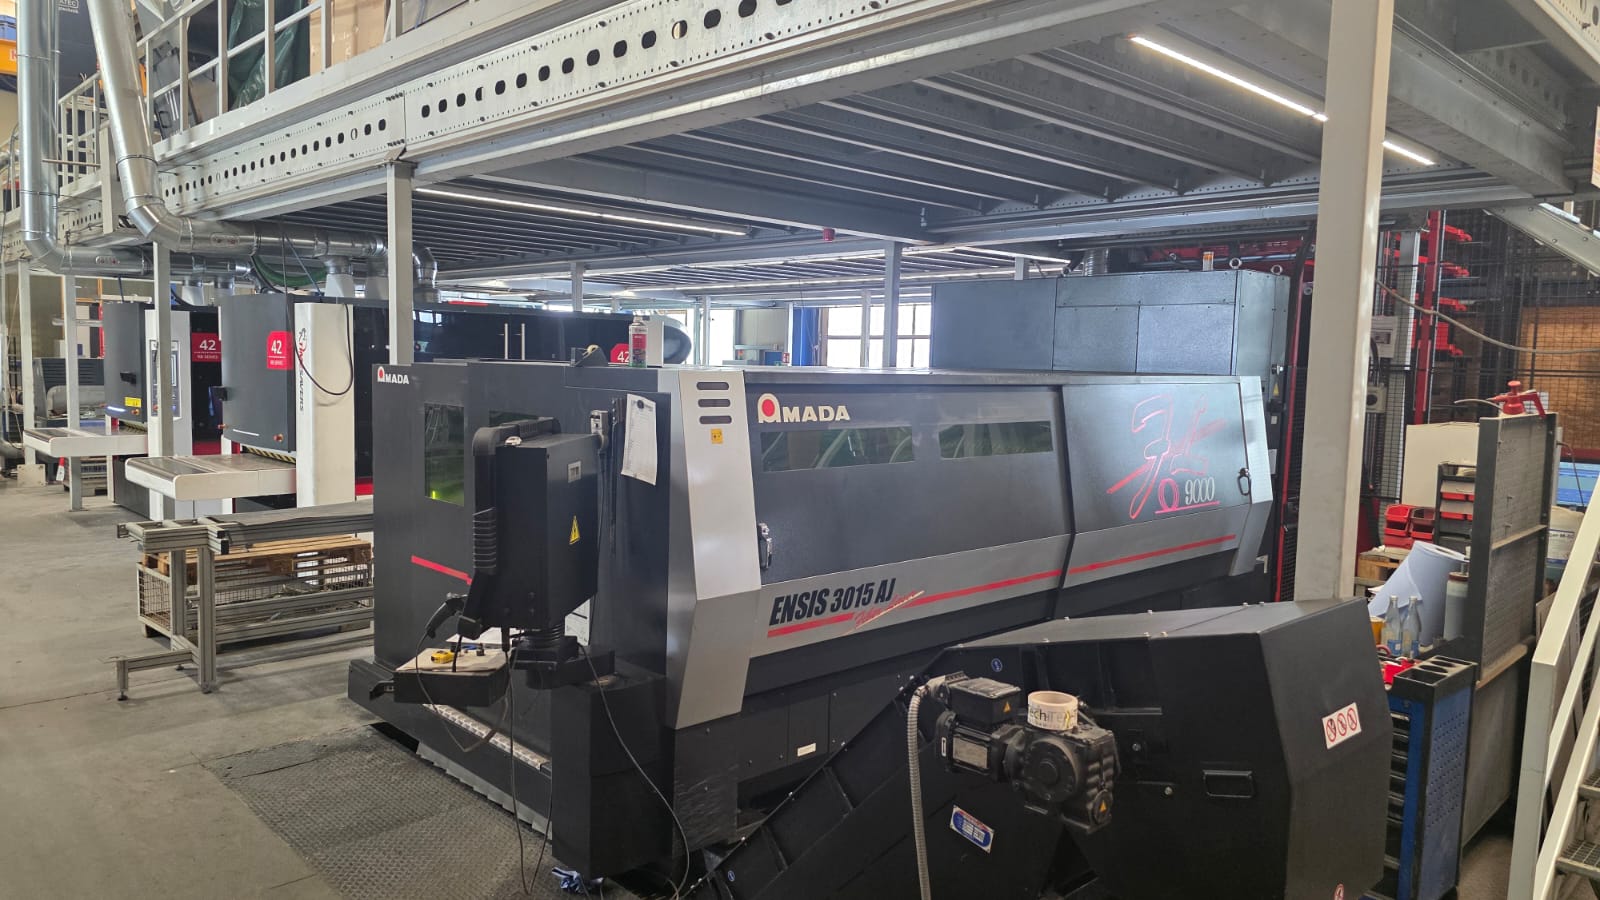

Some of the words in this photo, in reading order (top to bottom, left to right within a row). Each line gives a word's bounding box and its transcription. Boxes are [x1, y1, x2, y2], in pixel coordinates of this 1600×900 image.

[199, 339, 217, 351] 42
[271, 339, 283, 354] 42
[757, 393, 850, 423] AMADA
[1185, 477, 1215, 505] 9000
[769, 588, 829, 626] ENSIS
[830, 582, 875, 612] 3015
[875, 578, 896, 604] AJ
